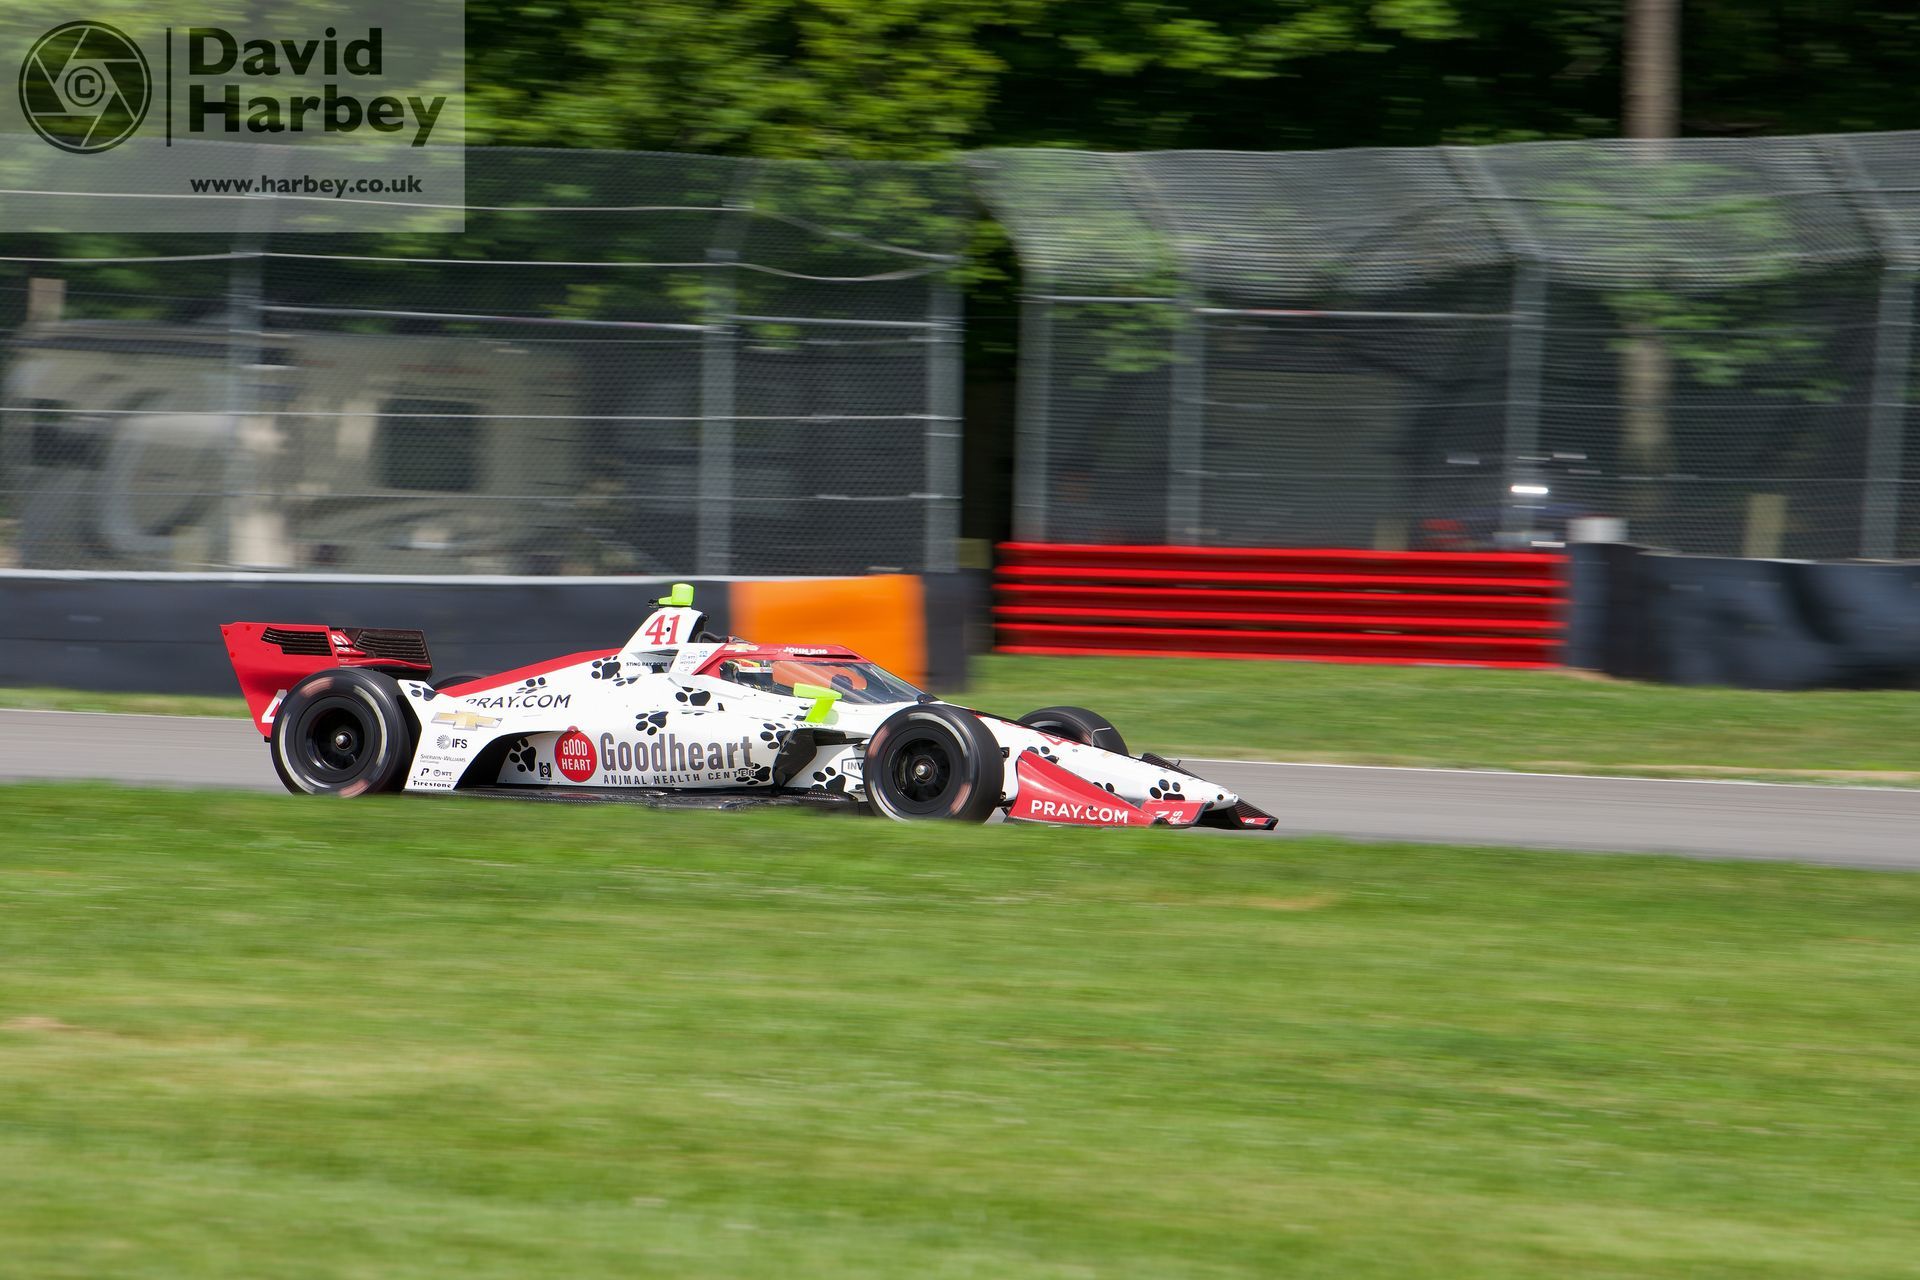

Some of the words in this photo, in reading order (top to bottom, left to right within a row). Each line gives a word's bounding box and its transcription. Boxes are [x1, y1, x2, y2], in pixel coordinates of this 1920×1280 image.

[644, 614, 681, 645] 41
[451, 738, 468, 749] IFS
[562, 738, 588, 757] GOOD
[600, 732, 753, 772] Goodheart
[561, 757, 591, 771] HEART
[413, 780, 452, 789] Firestone
[603, 774, 647, 785] ANIMAL
[653, 774, 700, 784] HEALTH
[707, 769, 755, 780] CENTER
[1030, 799, 1129, 824] PRAY.COM
